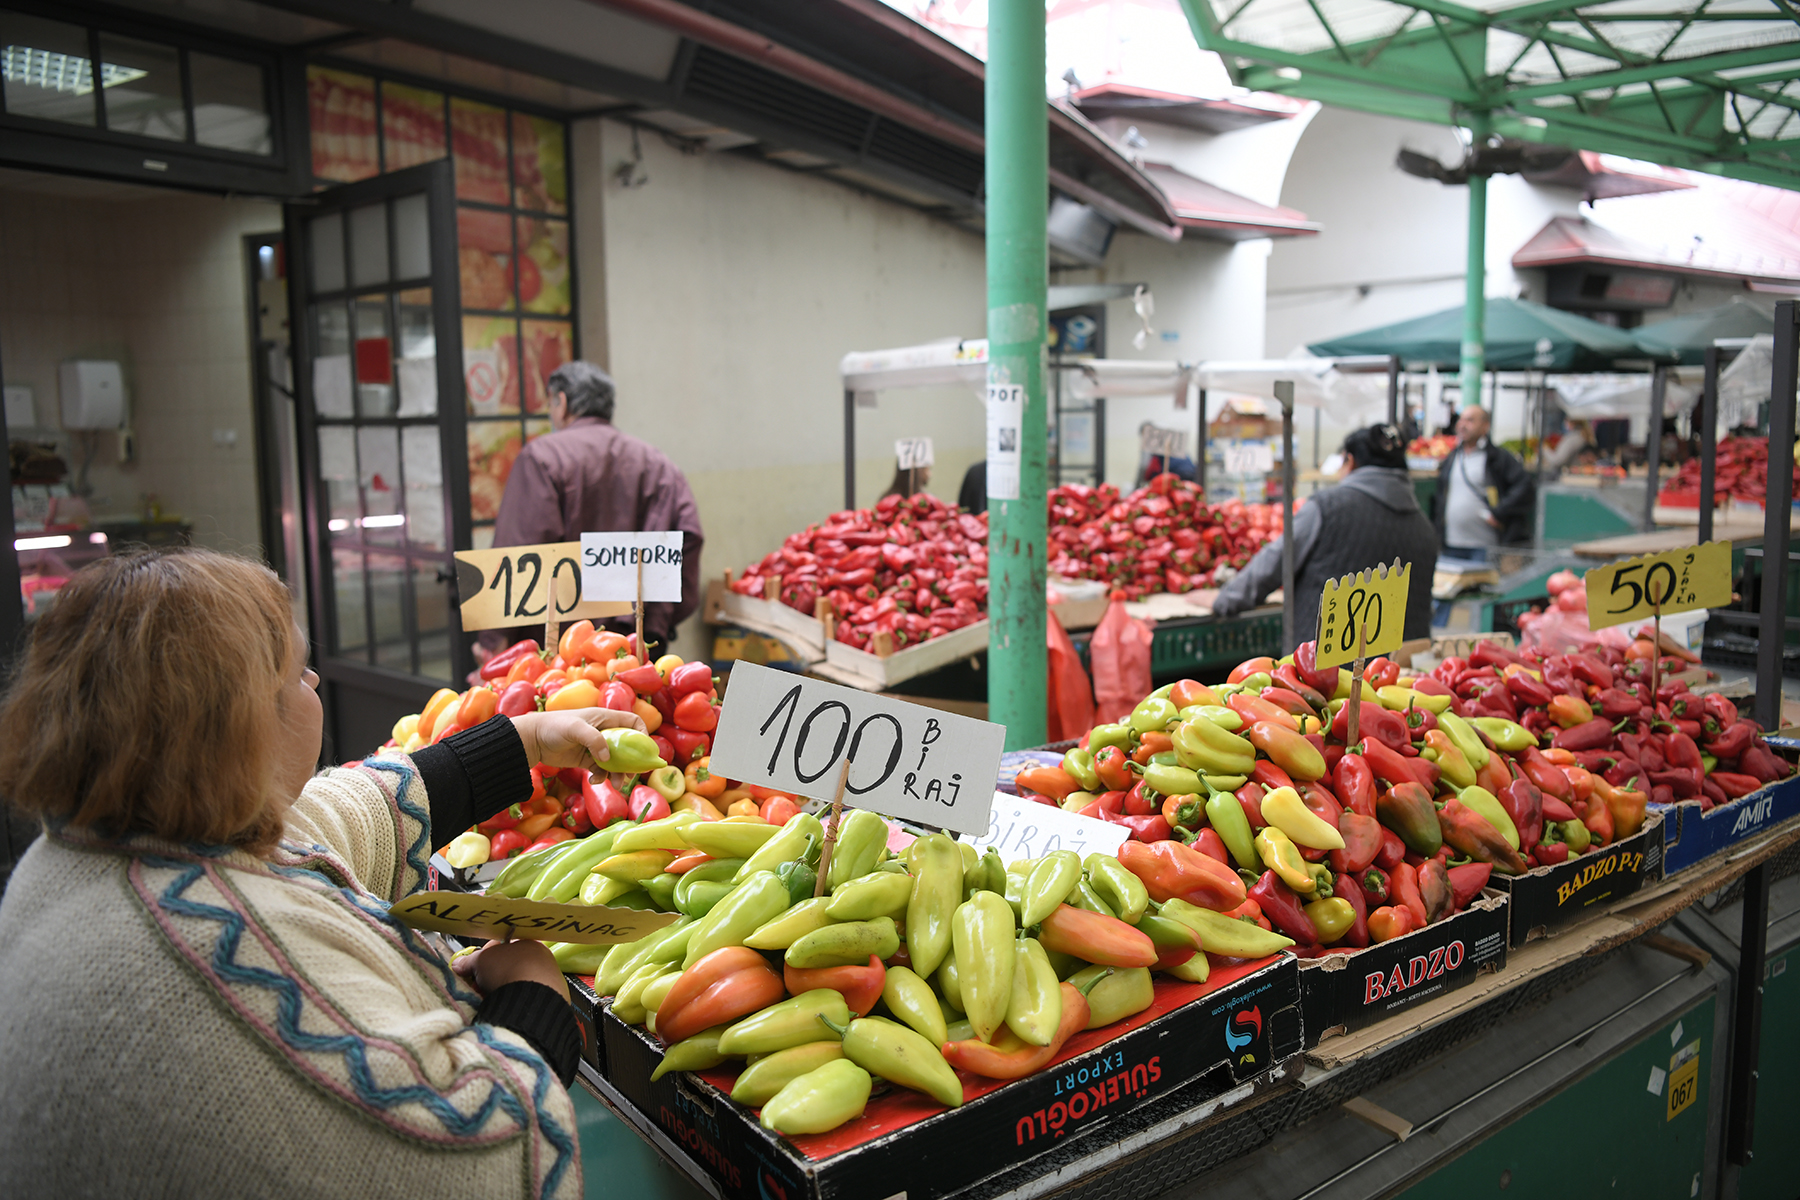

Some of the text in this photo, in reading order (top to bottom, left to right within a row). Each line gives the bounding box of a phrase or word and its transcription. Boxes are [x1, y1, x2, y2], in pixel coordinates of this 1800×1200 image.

[899, 440, 927, 465] 70
[584, 545, 683, 567] SOMBORKA
[489, 552, 582, 618] 120
[1606, 561, 1677, 614] 50
[1323, 597, 1337, 655] SANO
[1340, 588, 1382, 652] 80
[759, 684, 903, 795] 100
[1556, 854, 1618, 907] BADZO
[1363, 939, 1465, 1005] BADZO
[1016, 1055, 1162, 1146] SÜLEKOĞLU
[1053, 1051, 1125, 1097] EXPORT
[1671, 1076, 1695, 1111] 067
